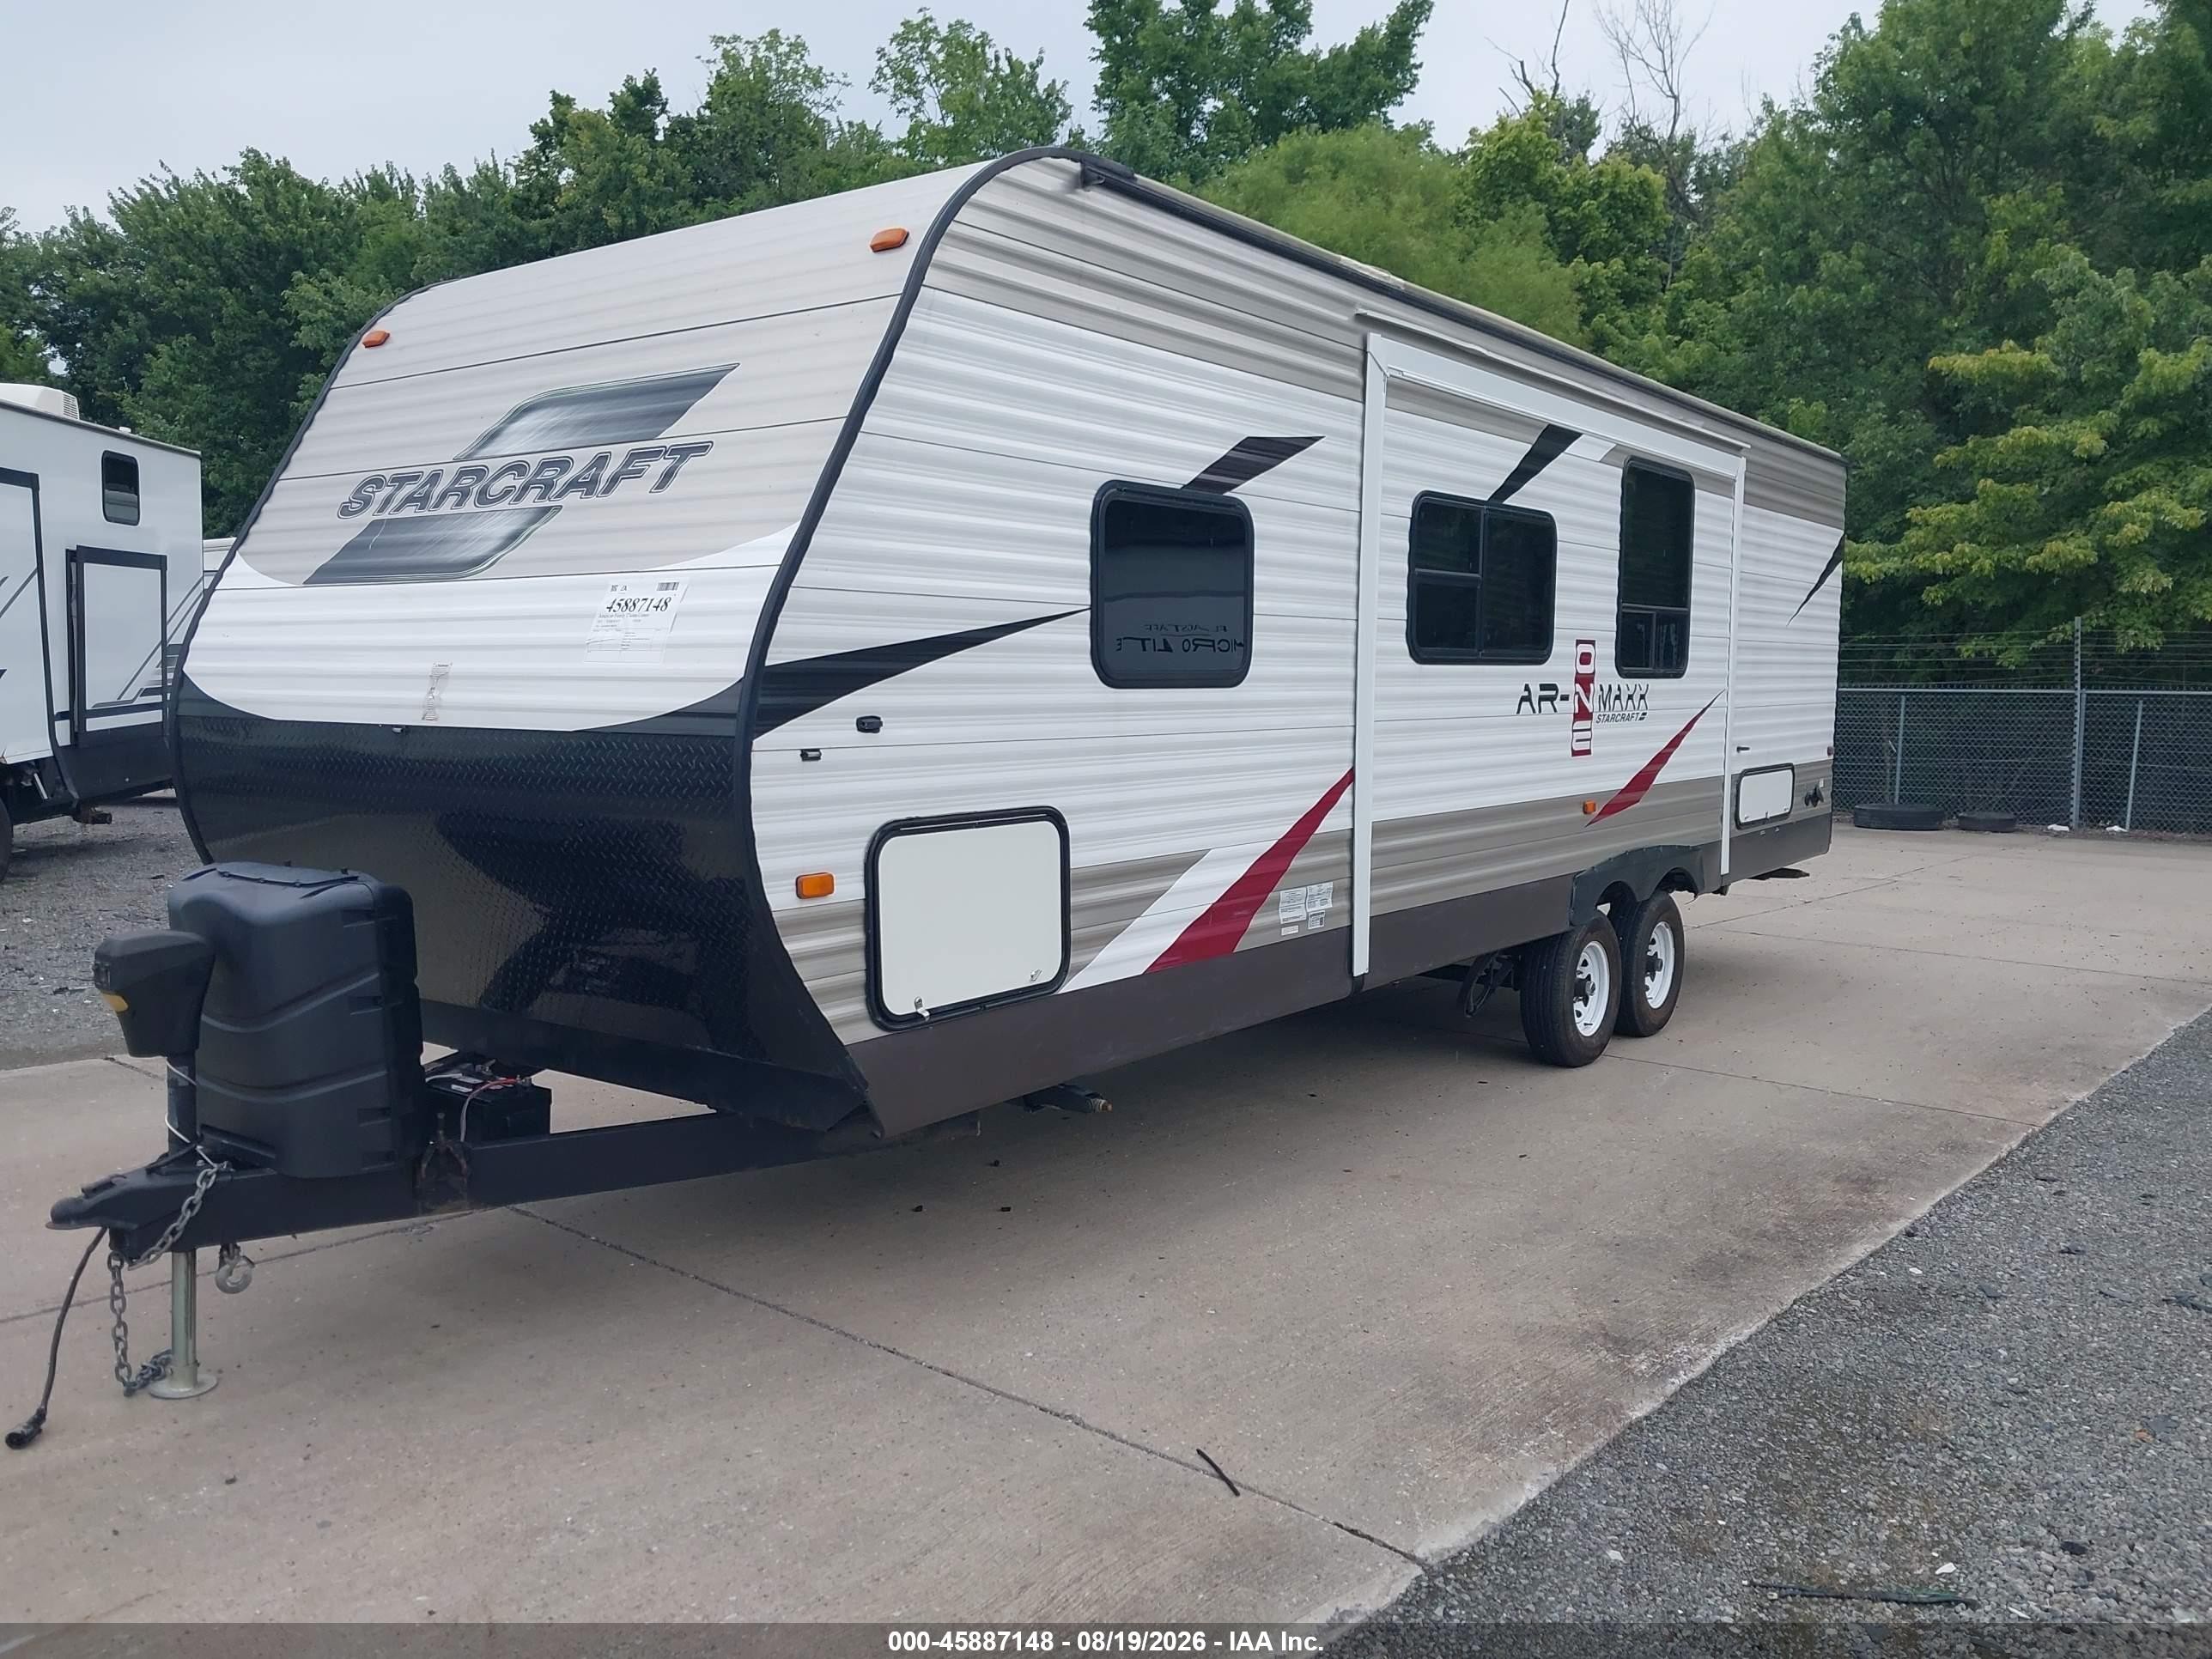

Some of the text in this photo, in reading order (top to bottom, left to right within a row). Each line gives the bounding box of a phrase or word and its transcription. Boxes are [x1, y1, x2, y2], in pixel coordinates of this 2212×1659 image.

[337, 441, 714, 520] STARCRAFT
[606, 597, 672, 613] 45887148
[1598, 683, 1650, 713] MAXX
[1595, 713, 1640, 724] STARCRAFT
